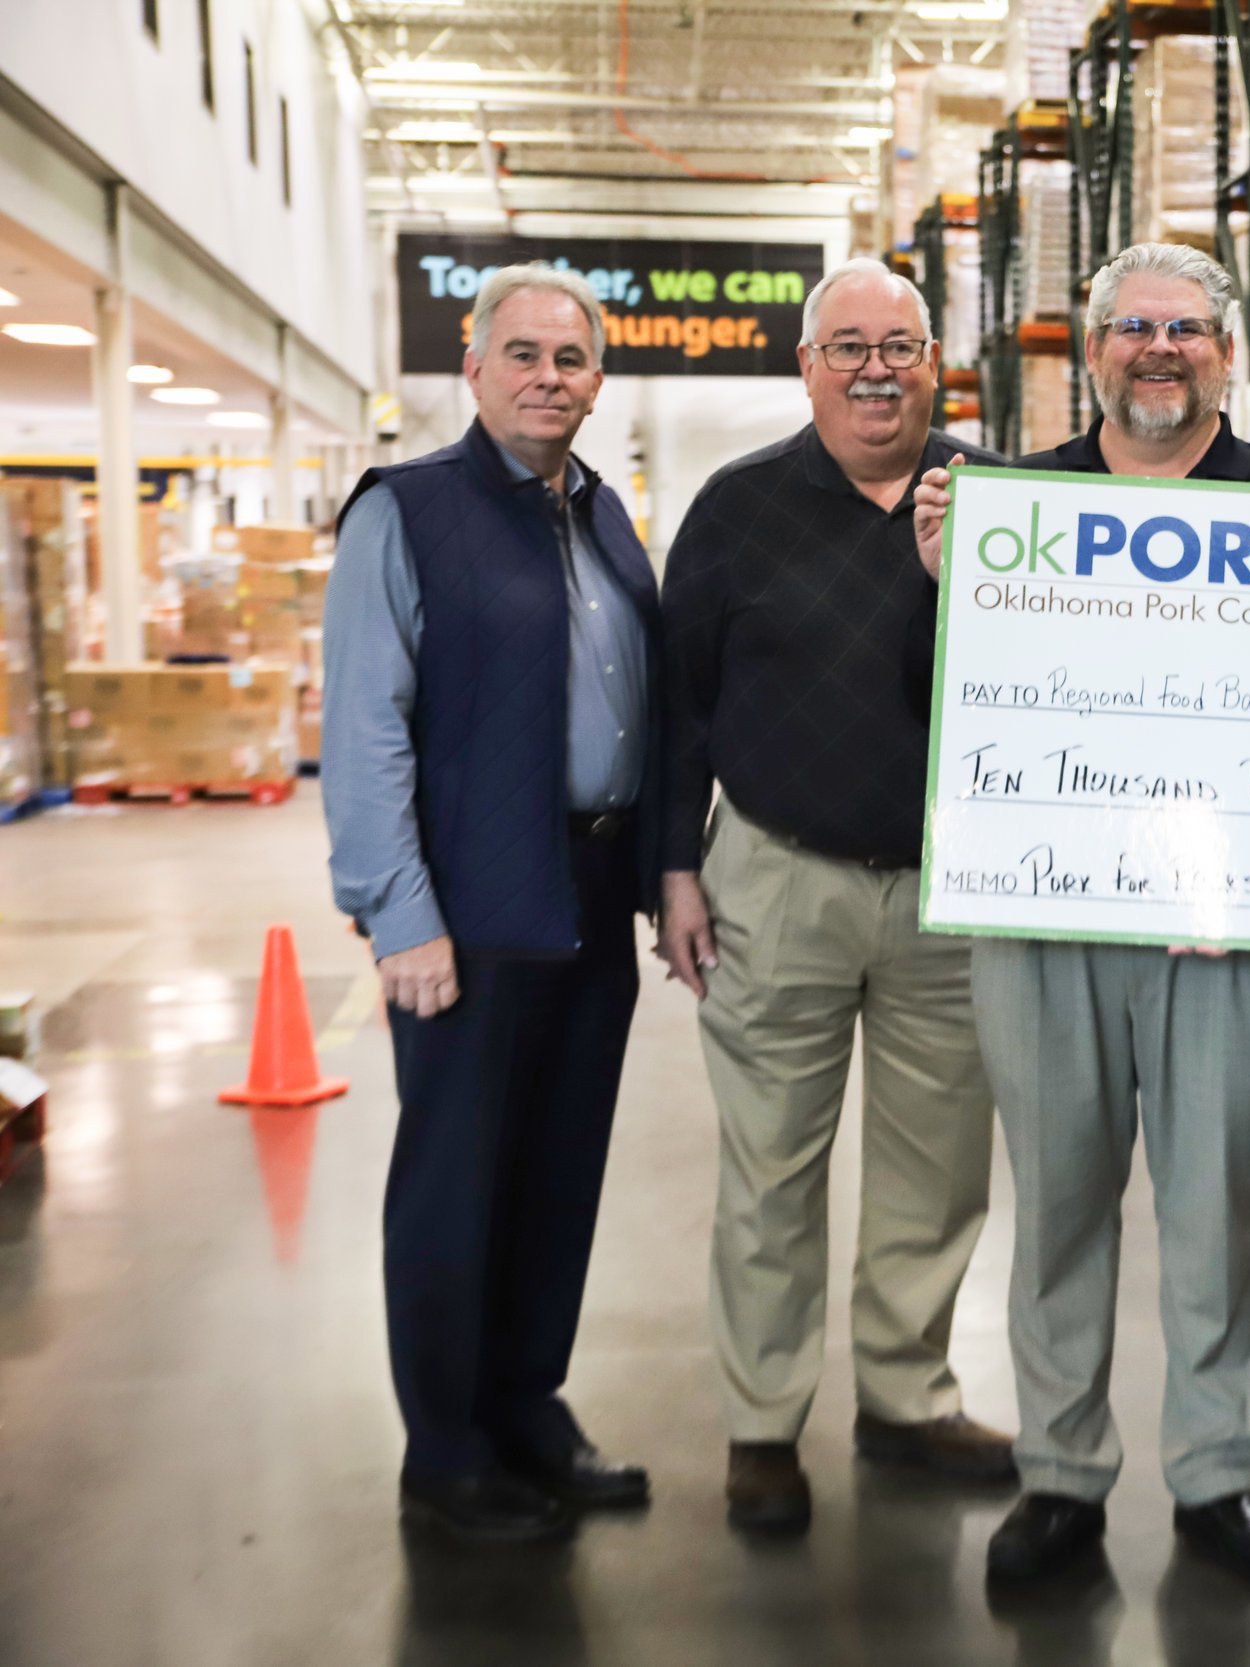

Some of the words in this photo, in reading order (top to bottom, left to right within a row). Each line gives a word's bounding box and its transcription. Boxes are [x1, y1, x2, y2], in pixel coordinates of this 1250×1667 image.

[419, 255, 644, 307] Toer,
[649, 269, 717, 303] we
[723, 270, 805, 304] can
[974, 583, 1133, 618] Oklahoma
[1145, 593, 1206, 623] Pork
[963, 682, 1003, 703] PAY
[1010, 685, 1039, 707] TO
[1047, 666, 1145, 718] Regional
[1157, 674, 1205, 712] Food
[945, 868, 1017, 894] MEMO
